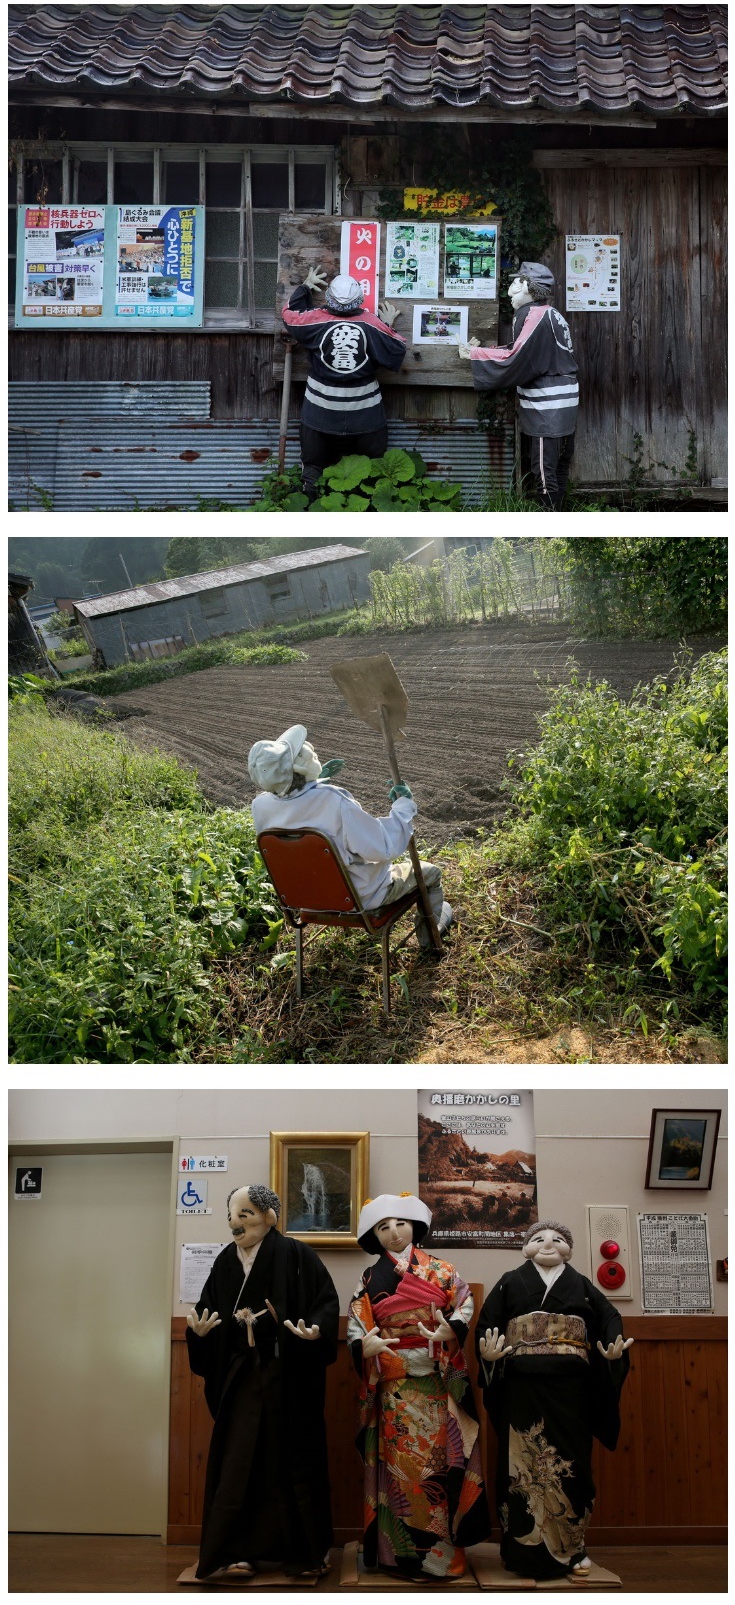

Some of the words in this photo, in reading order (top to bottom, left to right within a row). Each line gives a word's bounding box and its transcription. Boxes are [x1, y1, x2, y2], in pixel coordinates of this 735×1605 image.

[51, 209, 103, 219] 核兵器ゼロへ
[122, 215, 149, 223] 結成大会
[50, 219, 94, 229] 行動しよう
[166, 218, 180, 275] 心ひとつに
[180, 218, 193, 292] 新基地拒否で
[355, 227, 372, 313] 火の用
[45, 306, 83, 315] 日本共産党
[137, 306, 175, 315] 日本共産党
[431, 1093, 521, 1106] 奥播磨かかしの里
[199, 1159, 226, 1168] 化粧室
